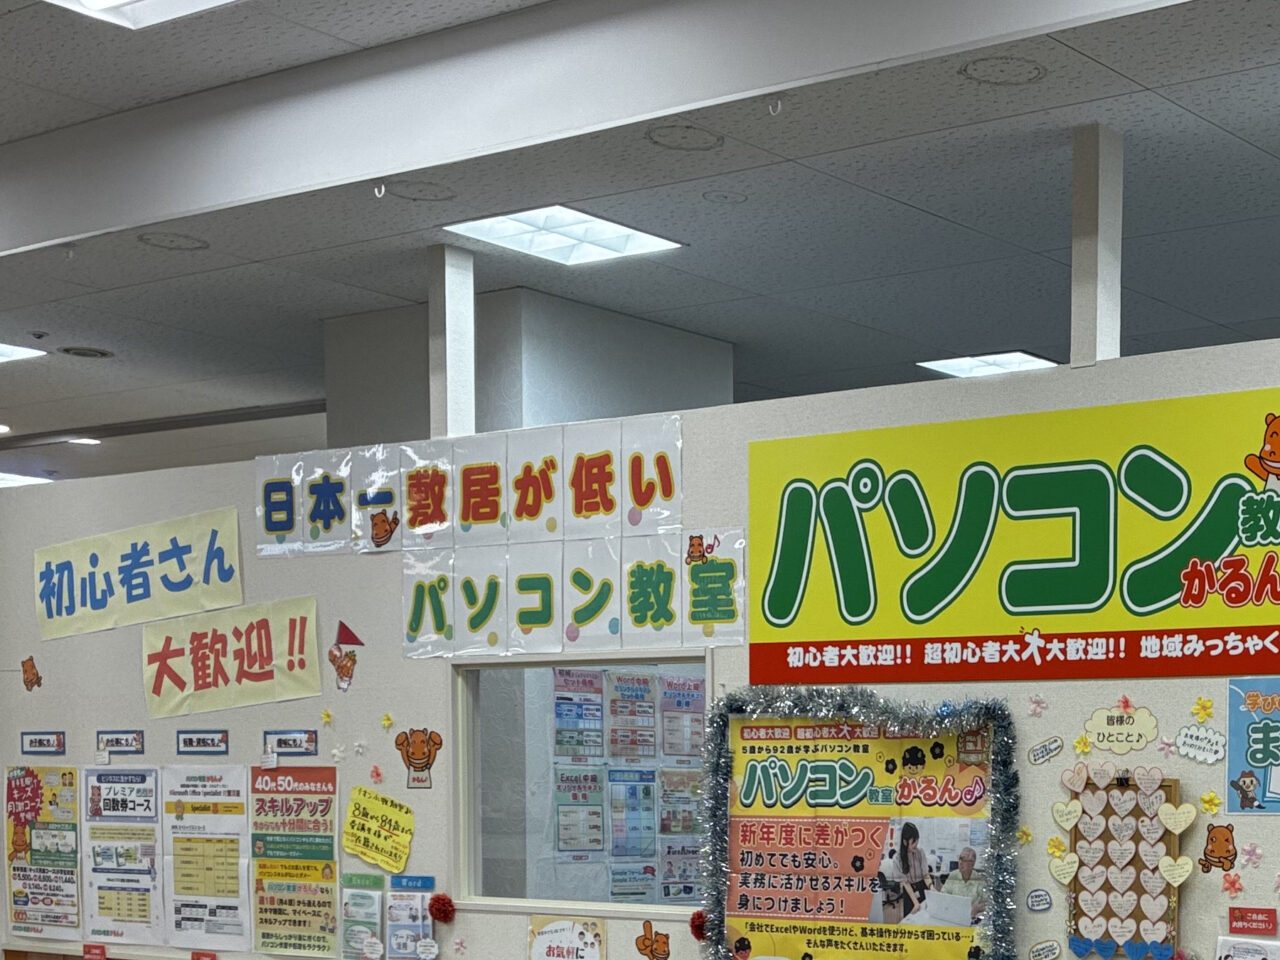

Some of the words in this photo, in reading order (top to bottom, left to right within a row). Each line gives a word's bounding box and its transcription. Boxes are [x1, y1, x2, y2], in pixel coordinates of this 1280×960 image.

[262, 450, 675, 535] 日本一敷居が低い
[760, 445, 1258, 629] パソコン
[38, 528, 236, 620] 初心者さん
[406, 558, 738, 637] パソコン教室
[147, 616, 308, 696] 大歓迎!!
[786, 639, 911, 668] 初心者大歓迎!!
[1106, 715, 1135, 726] 皆様の
[743, 728, 790, 738] 初心者大歓迎
[742, 744, 870, 754] 5歳から92歳が学ぶパソコン教室
[740, 755, 875, 808] パソコン
[867, 786, 894, 805] 教室
[896, 775, 961, 806] かるん
[103, 799, 152, 812] 回数券コース
[255, 797, 333, 817] スキルアップ
[740, 822, 895, 848] 新年度に差がつく!
[401, 878, 422, 887] Word
[738, 874, 881, 893] 実務に活かせるスキルを
[737, 894, 845, 914] 身につけましょう!
[545, 944, 586, 960] お気軽に
